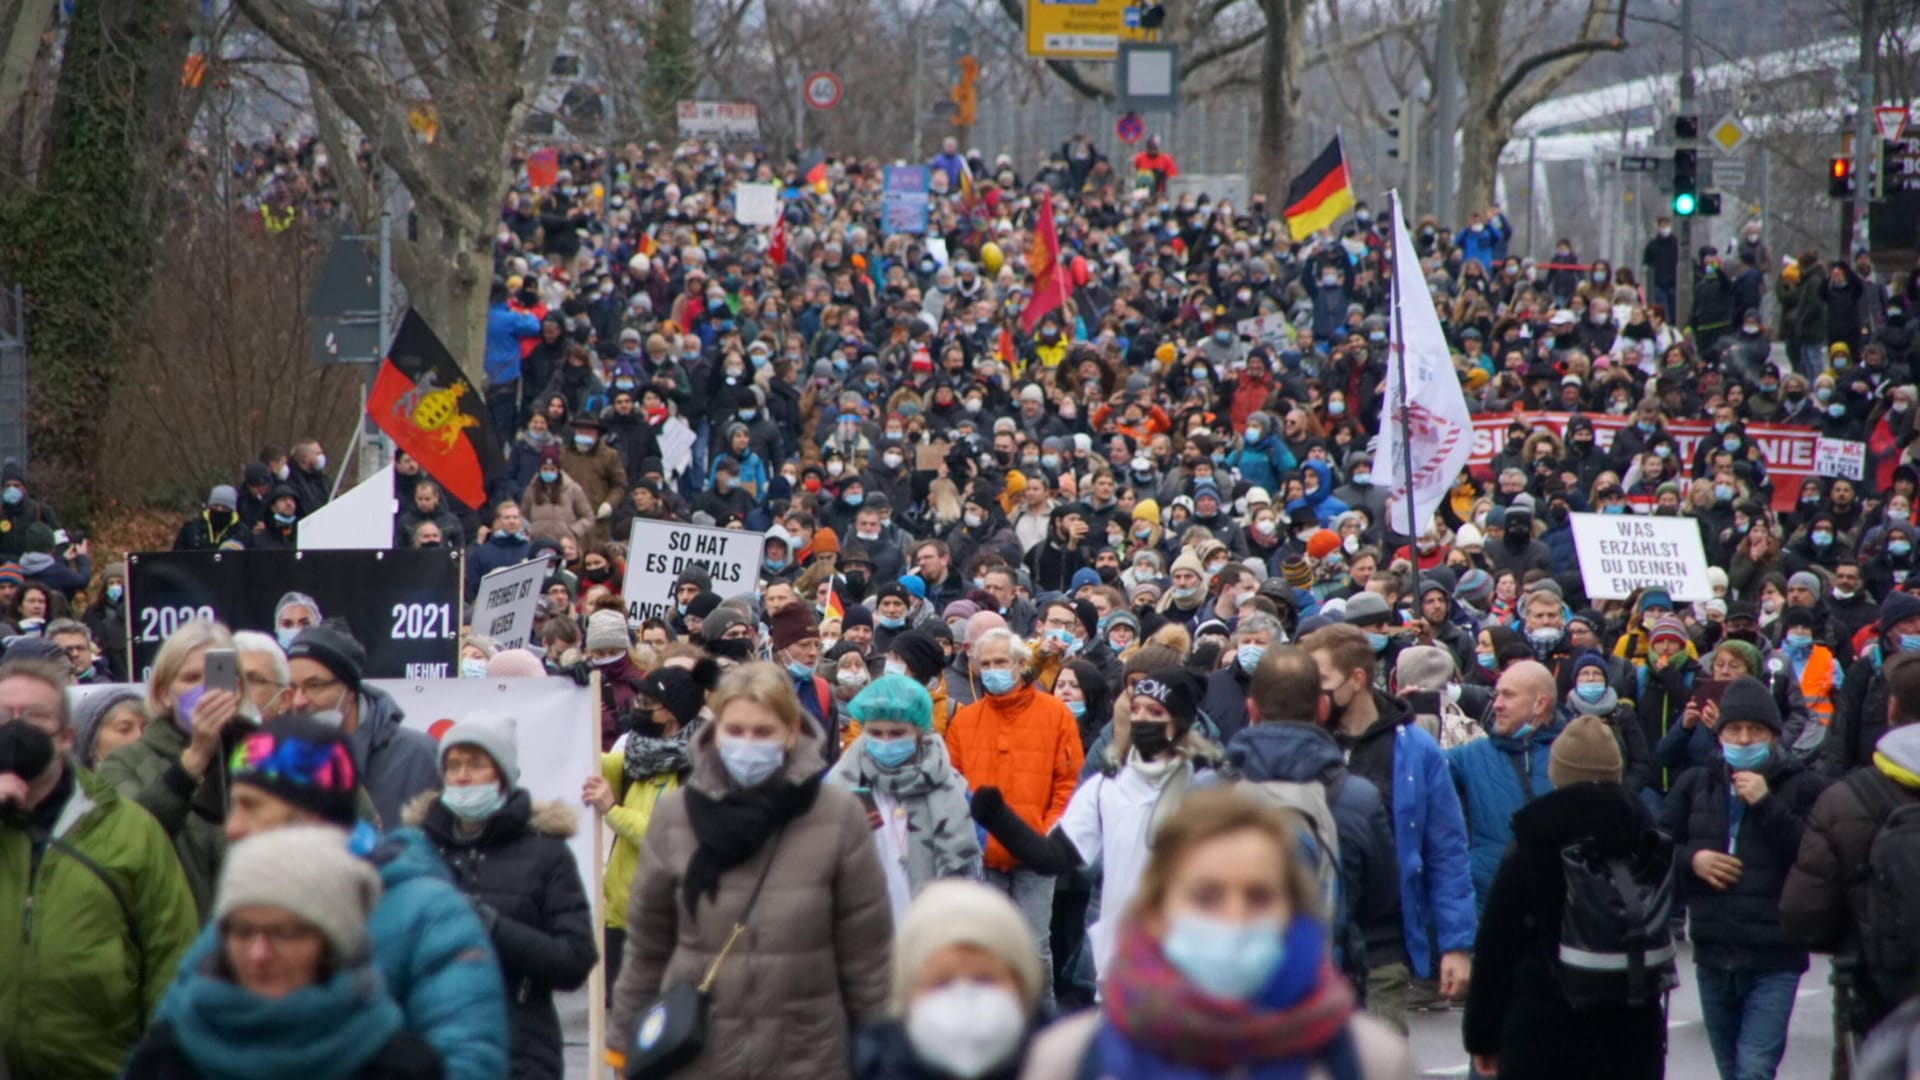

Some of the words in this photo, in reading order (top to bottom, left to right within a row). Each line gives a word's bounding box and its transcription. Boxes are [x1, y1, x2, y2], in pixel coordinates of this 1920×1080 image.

[1616, 521, 1655, 538] WAS
[668, 531, 691, 552] SO
[695, 534, 728, 556] HAT
[646, 553, 667, 574] ES
[672, 556, 741, 582] DALS
[1601, 559, 1623, 574] DU
[1627, 560, 1688, 577] DEINEN
[487, 582, 519, 609] FREIHEIT
[391, 603, 450, 638] 2021
[405, 662, 448, 680] NEHMT
